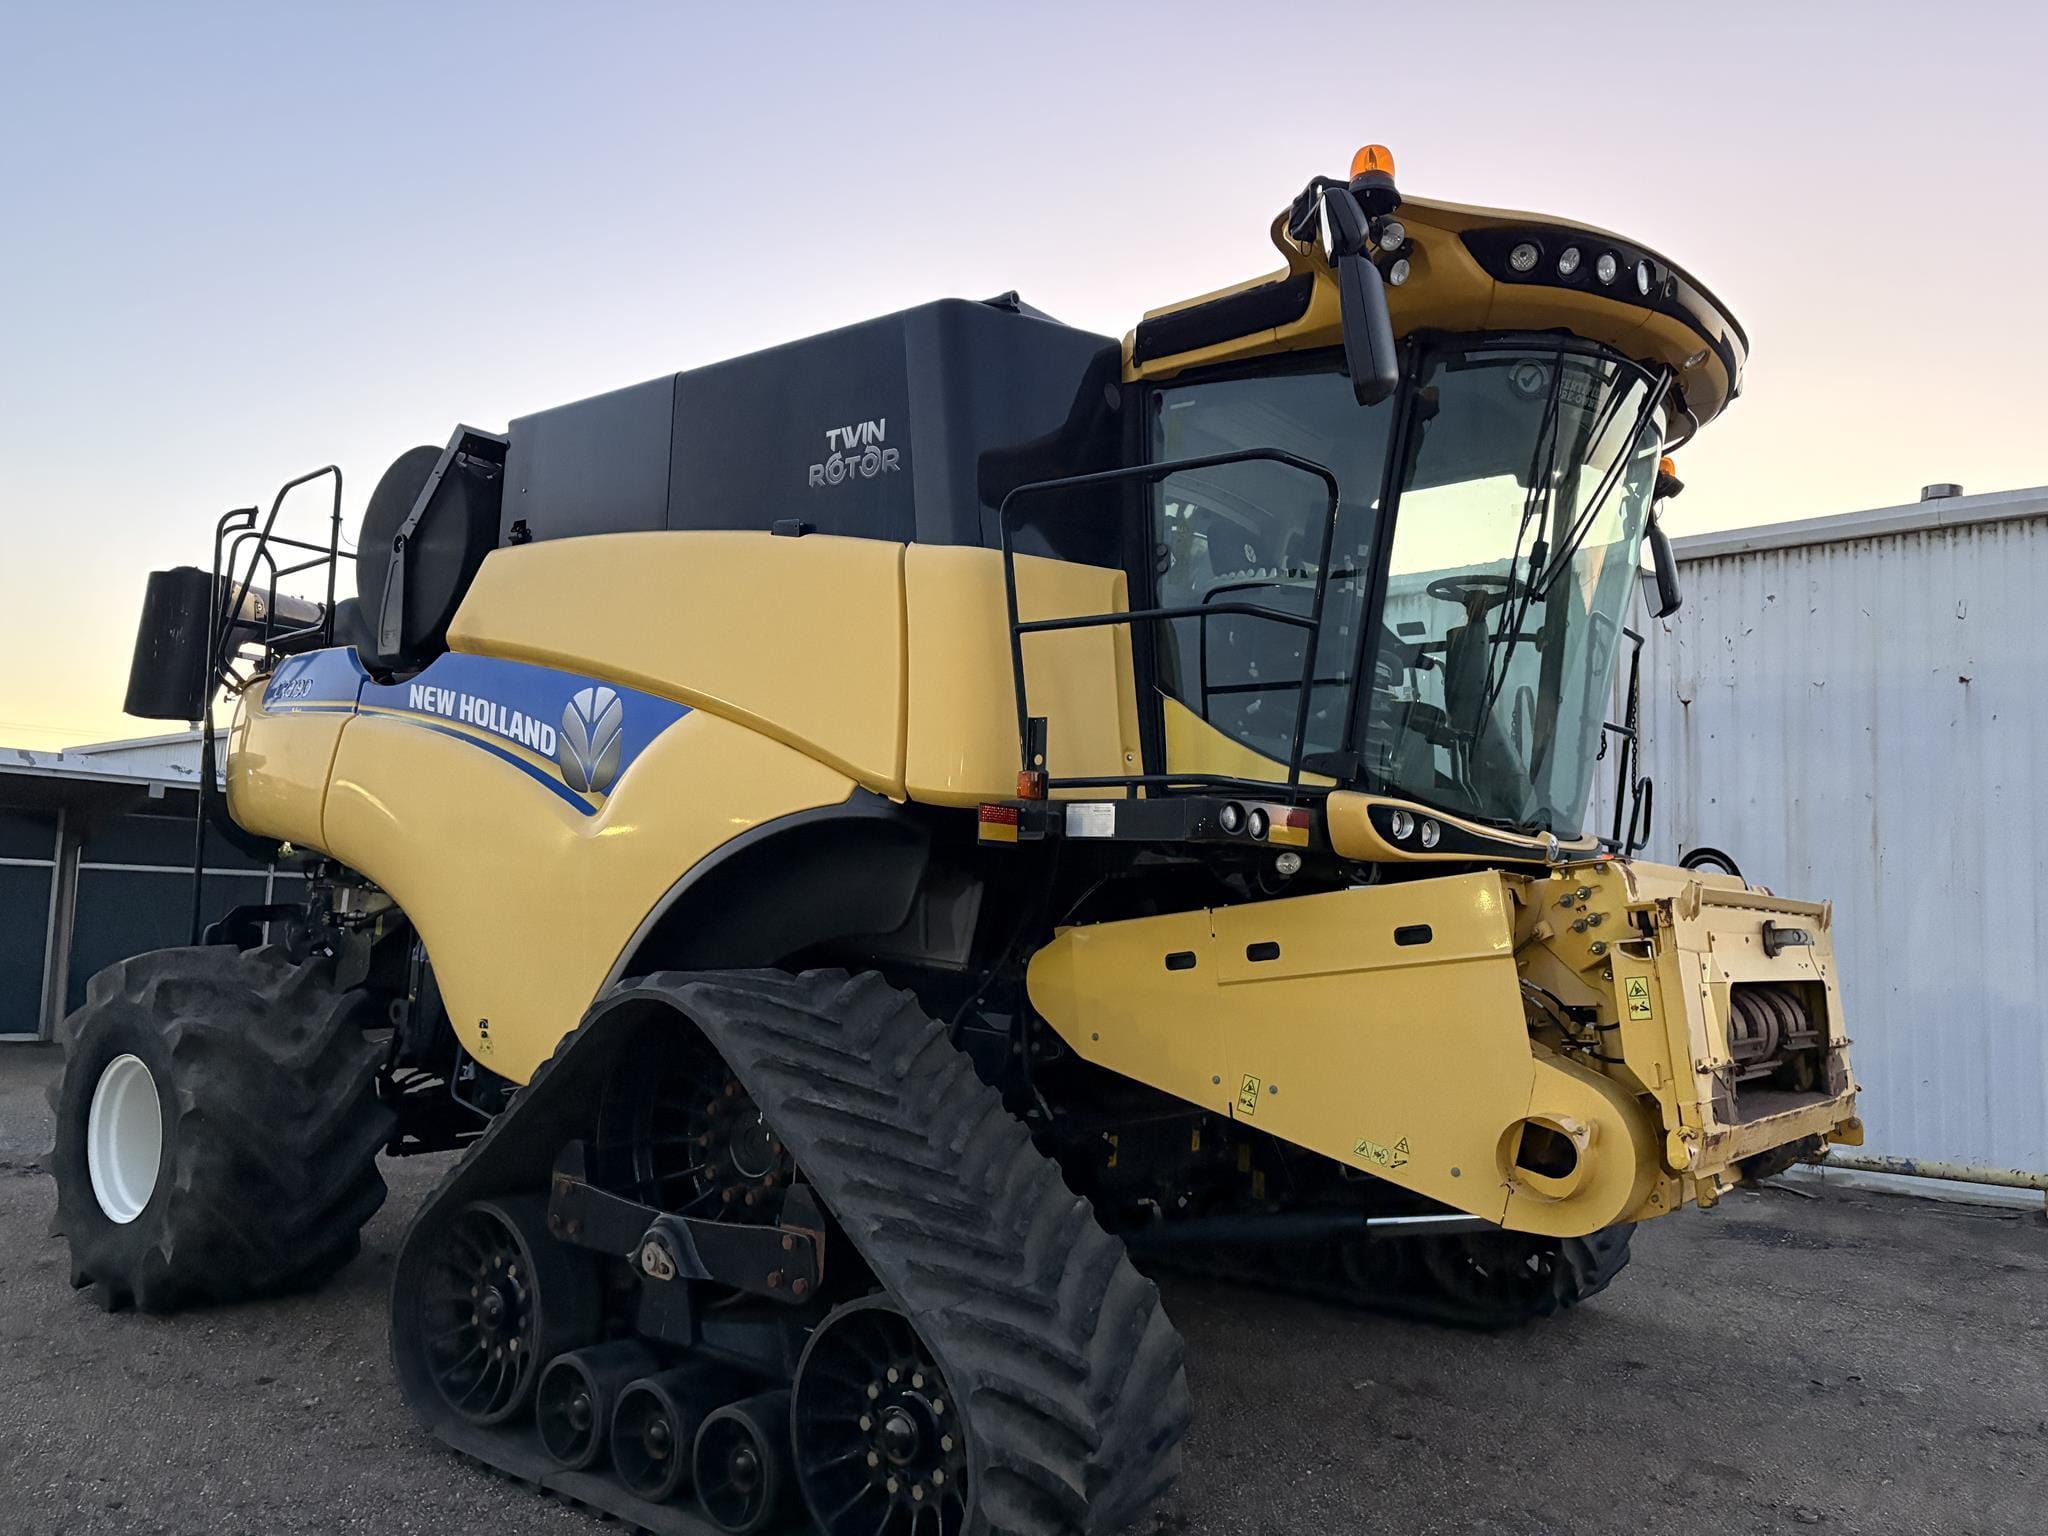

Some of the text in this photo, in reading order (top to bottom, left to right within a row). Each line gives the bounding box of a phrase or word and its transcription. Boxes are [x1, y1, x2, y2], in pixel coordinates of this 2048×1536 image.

[826, 418, 885, 452] TWIN
[808, 444, 900, 488] ROTOR
[409, 684, 556, 757] NEW HOLLAND
